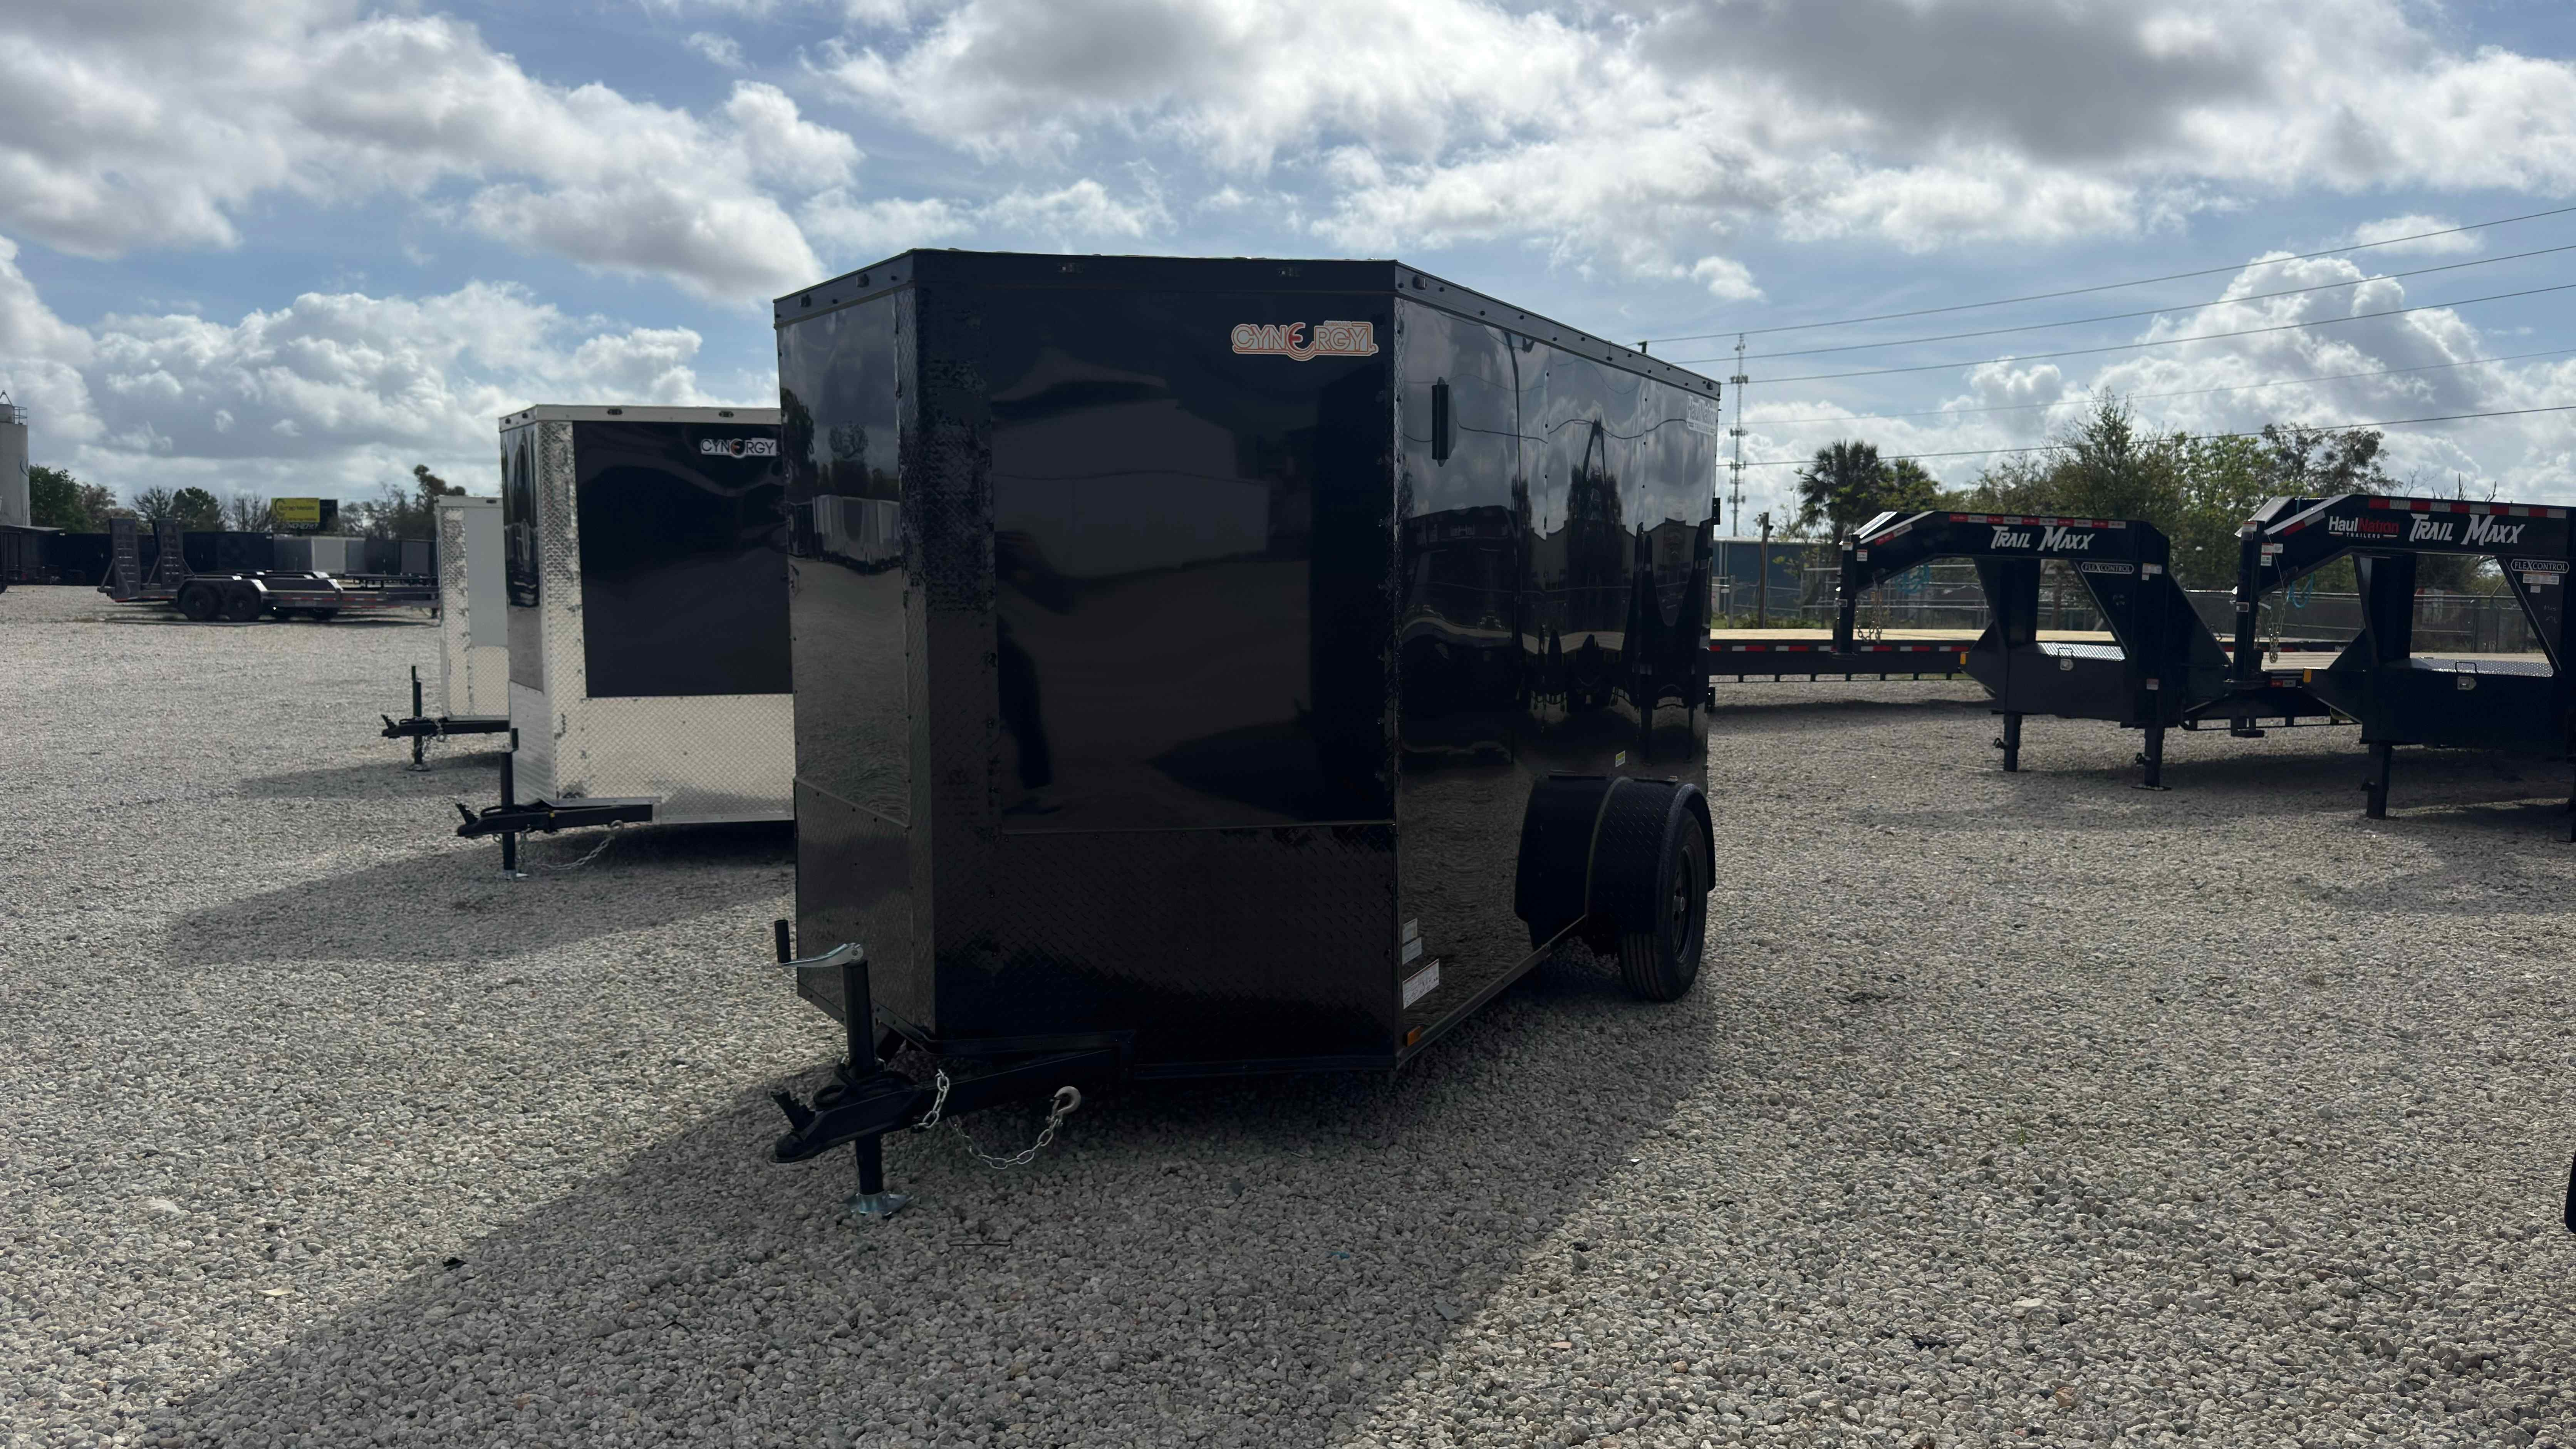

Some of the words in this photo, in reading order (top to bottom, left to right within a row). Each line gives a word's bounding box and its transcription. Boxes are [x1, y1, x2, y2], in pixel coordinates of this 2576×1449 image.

[1233, 322, 1371, 355] CYNERGY
[701, 438, 775, 456] CYNERGY
[2328, 516, 2400, 534] HaulNation
[2409, 513, 2454, 542] TRAIL
[2460, 514, 2526, 546] MAXX
[1991, 525, 2031, 549] TRAIL
[2037, 526, 2095, 552] MAXX
[2085, 563, 2131, 572] FLEXCONTROL
[2514, 560, 2566, 571] FLEXCONTROL
